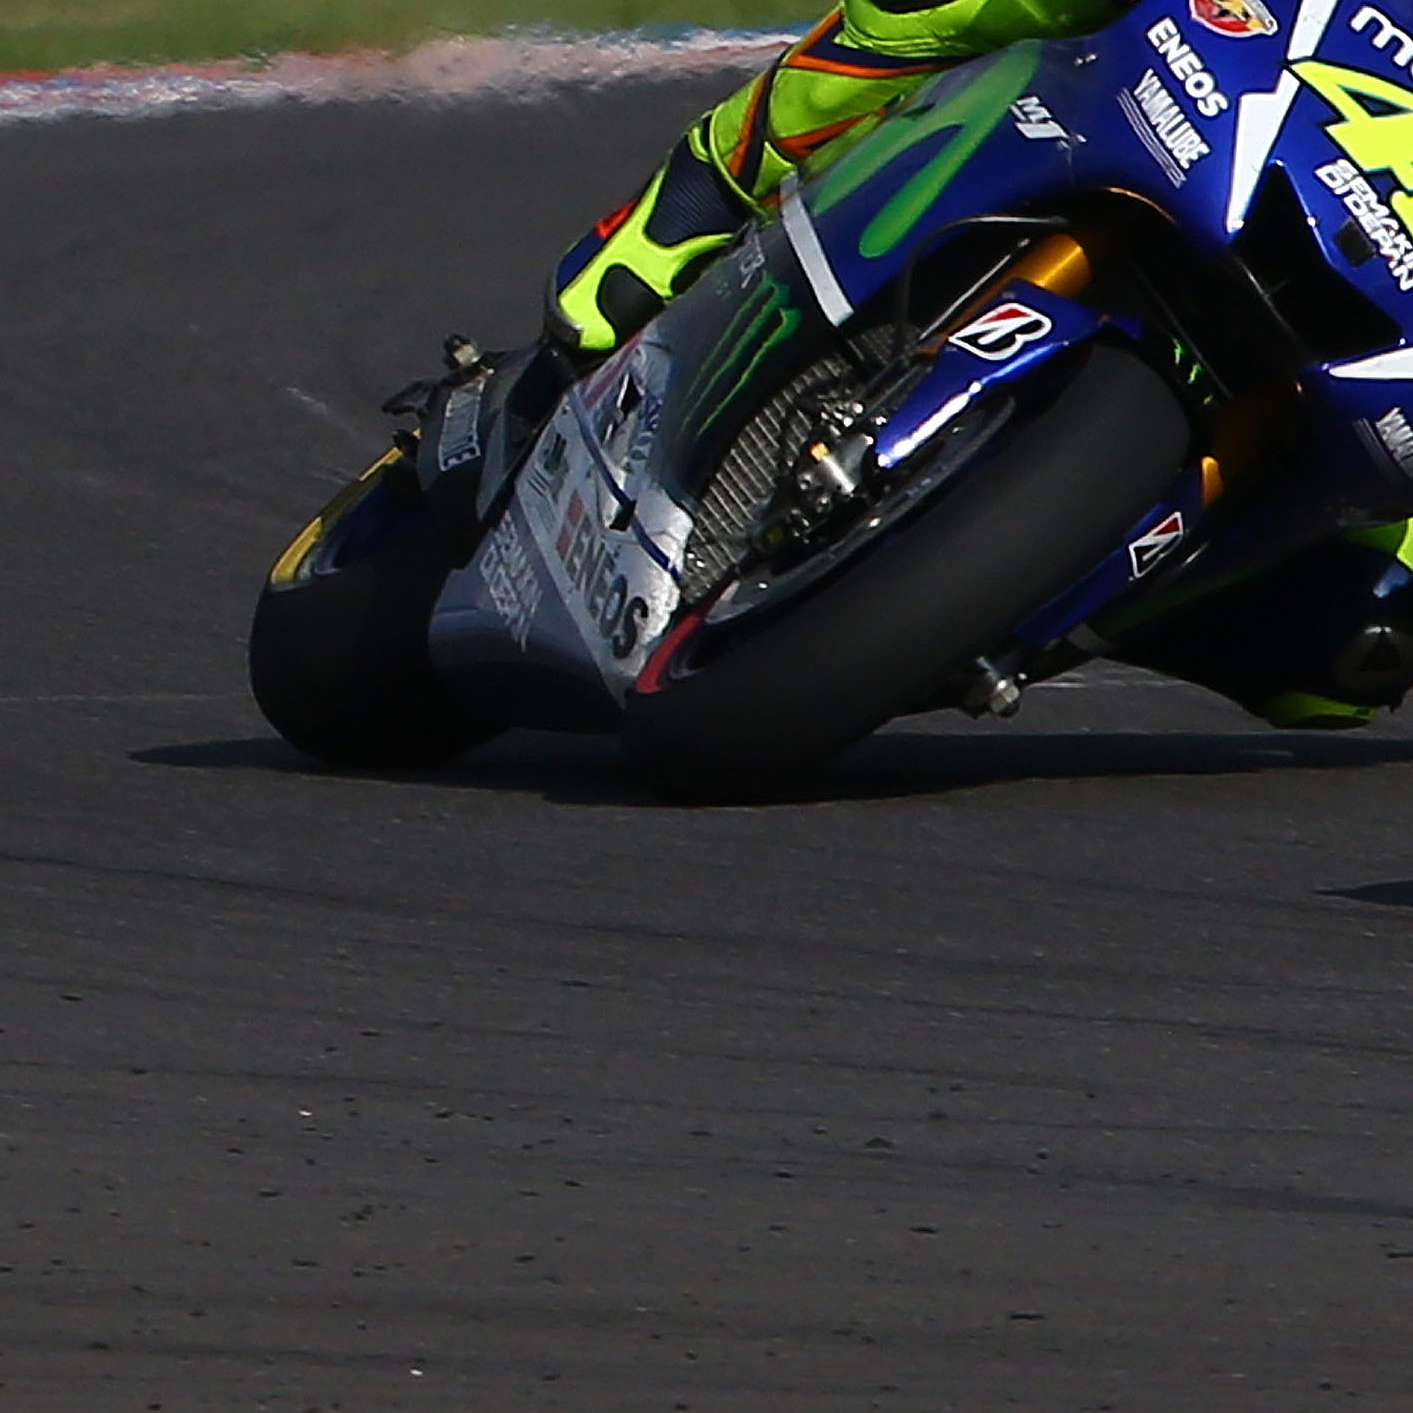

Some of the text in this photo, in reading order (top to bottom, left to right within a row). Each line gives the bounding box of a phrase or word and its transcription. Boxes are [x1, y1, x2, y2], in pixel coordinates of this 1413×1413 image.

[1147, 17, 1228, 116] ENEOS
[1134, 68, 1210, 169] YAMALUBE
[566, 515, 649, 660] ENEOS
